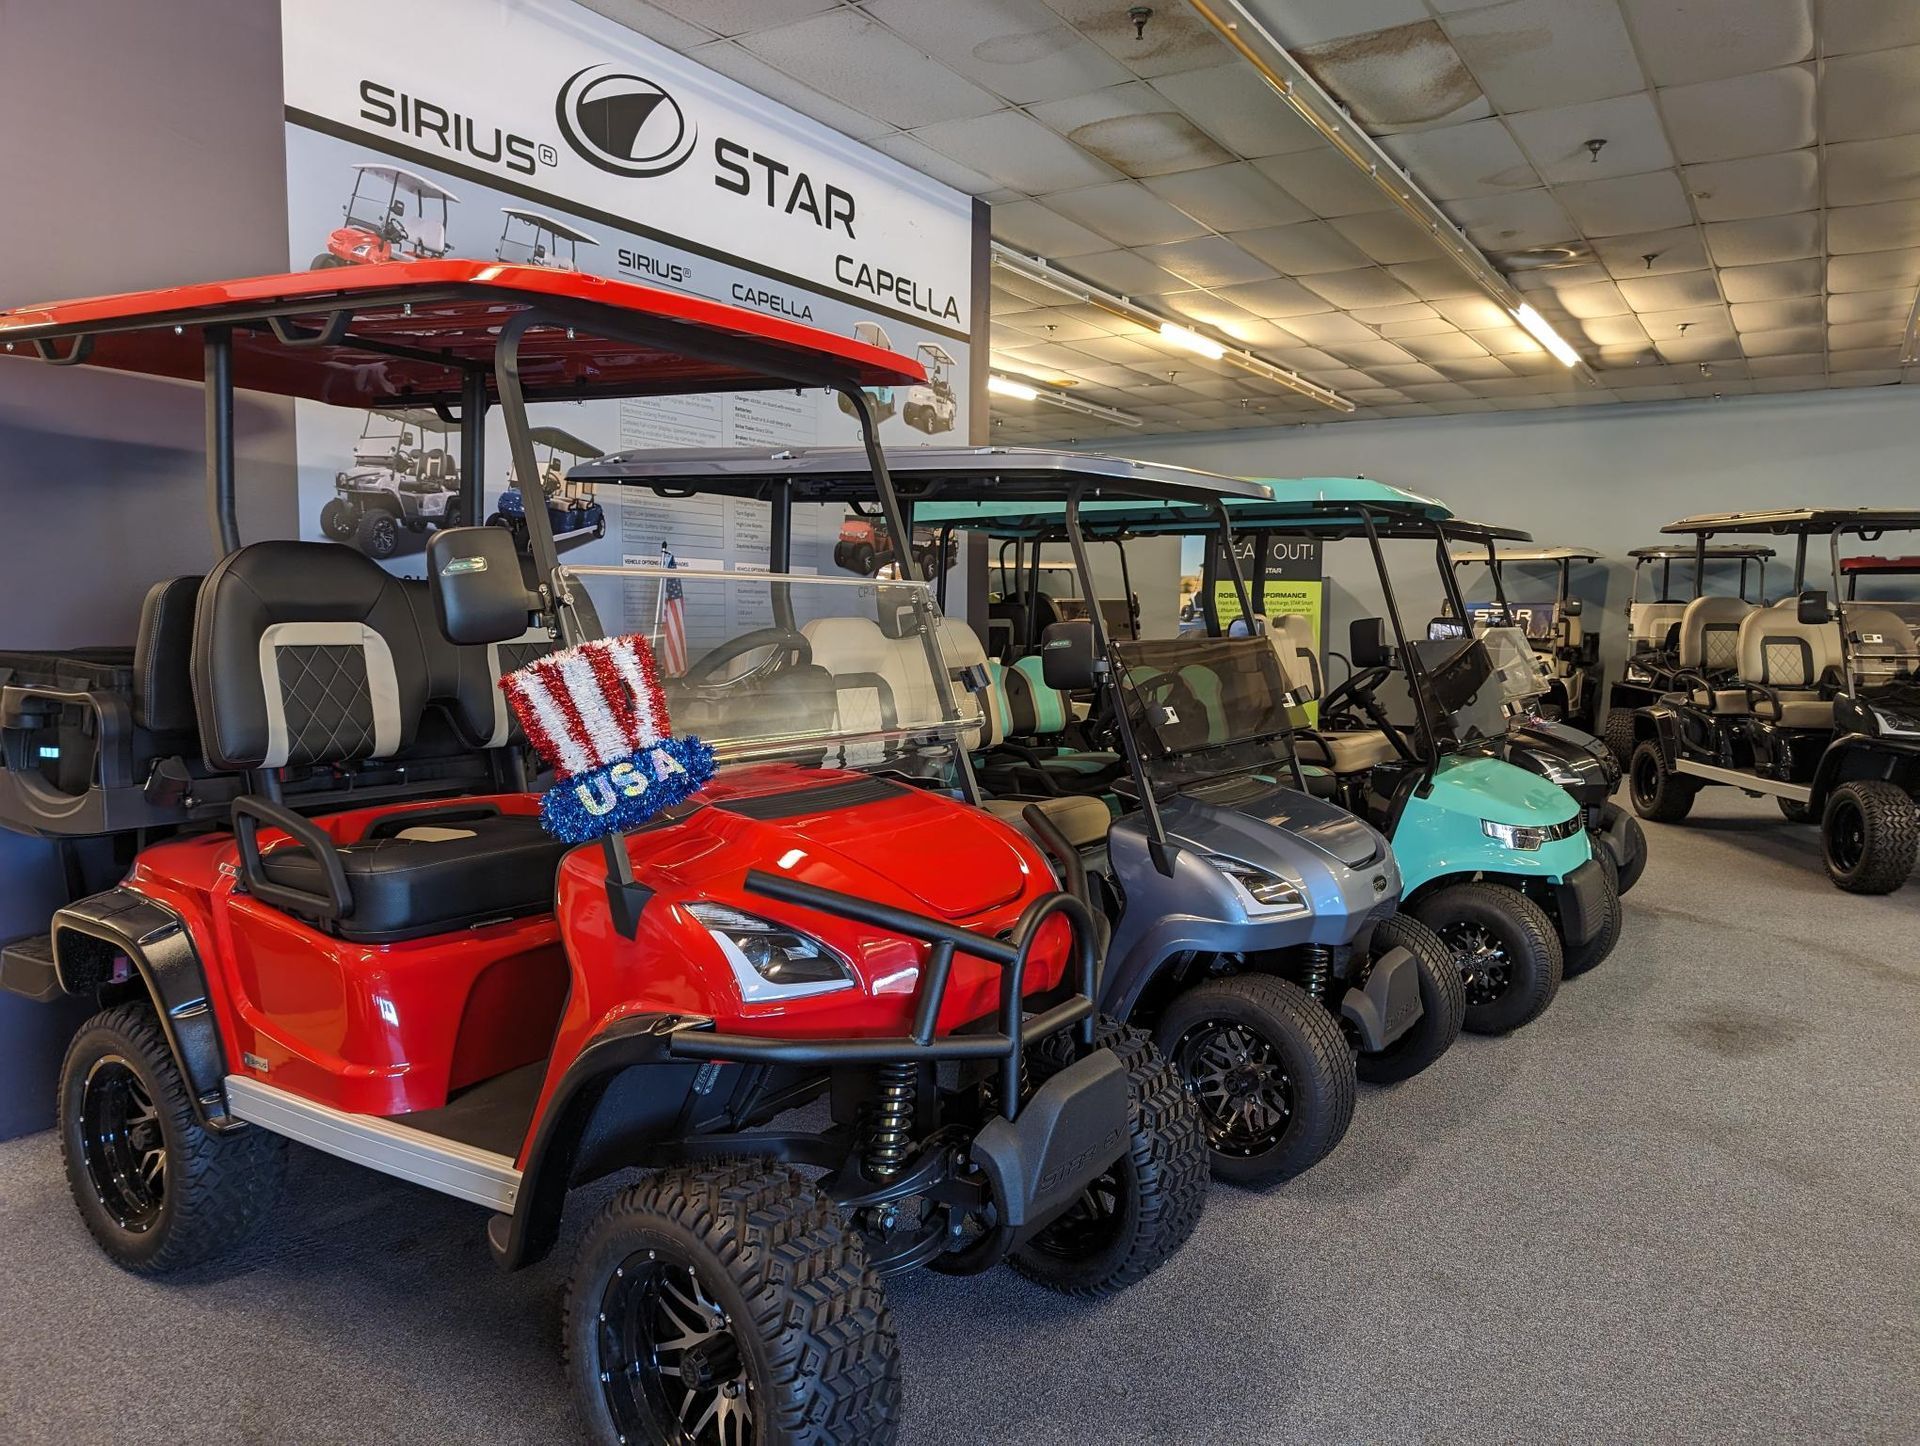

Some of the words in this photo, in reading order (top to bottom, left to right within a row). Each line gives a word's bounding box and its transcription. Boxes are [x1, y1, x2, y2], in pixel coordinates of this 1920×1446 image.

[714, 137, 856, 240] STAR
[731, 283, 814, 322] CAPELLA
[835, 254, 961, 324] CAPELLA
[1273, 543, 1314, 560] OUT!
[575, 748, 687, 816] USA
